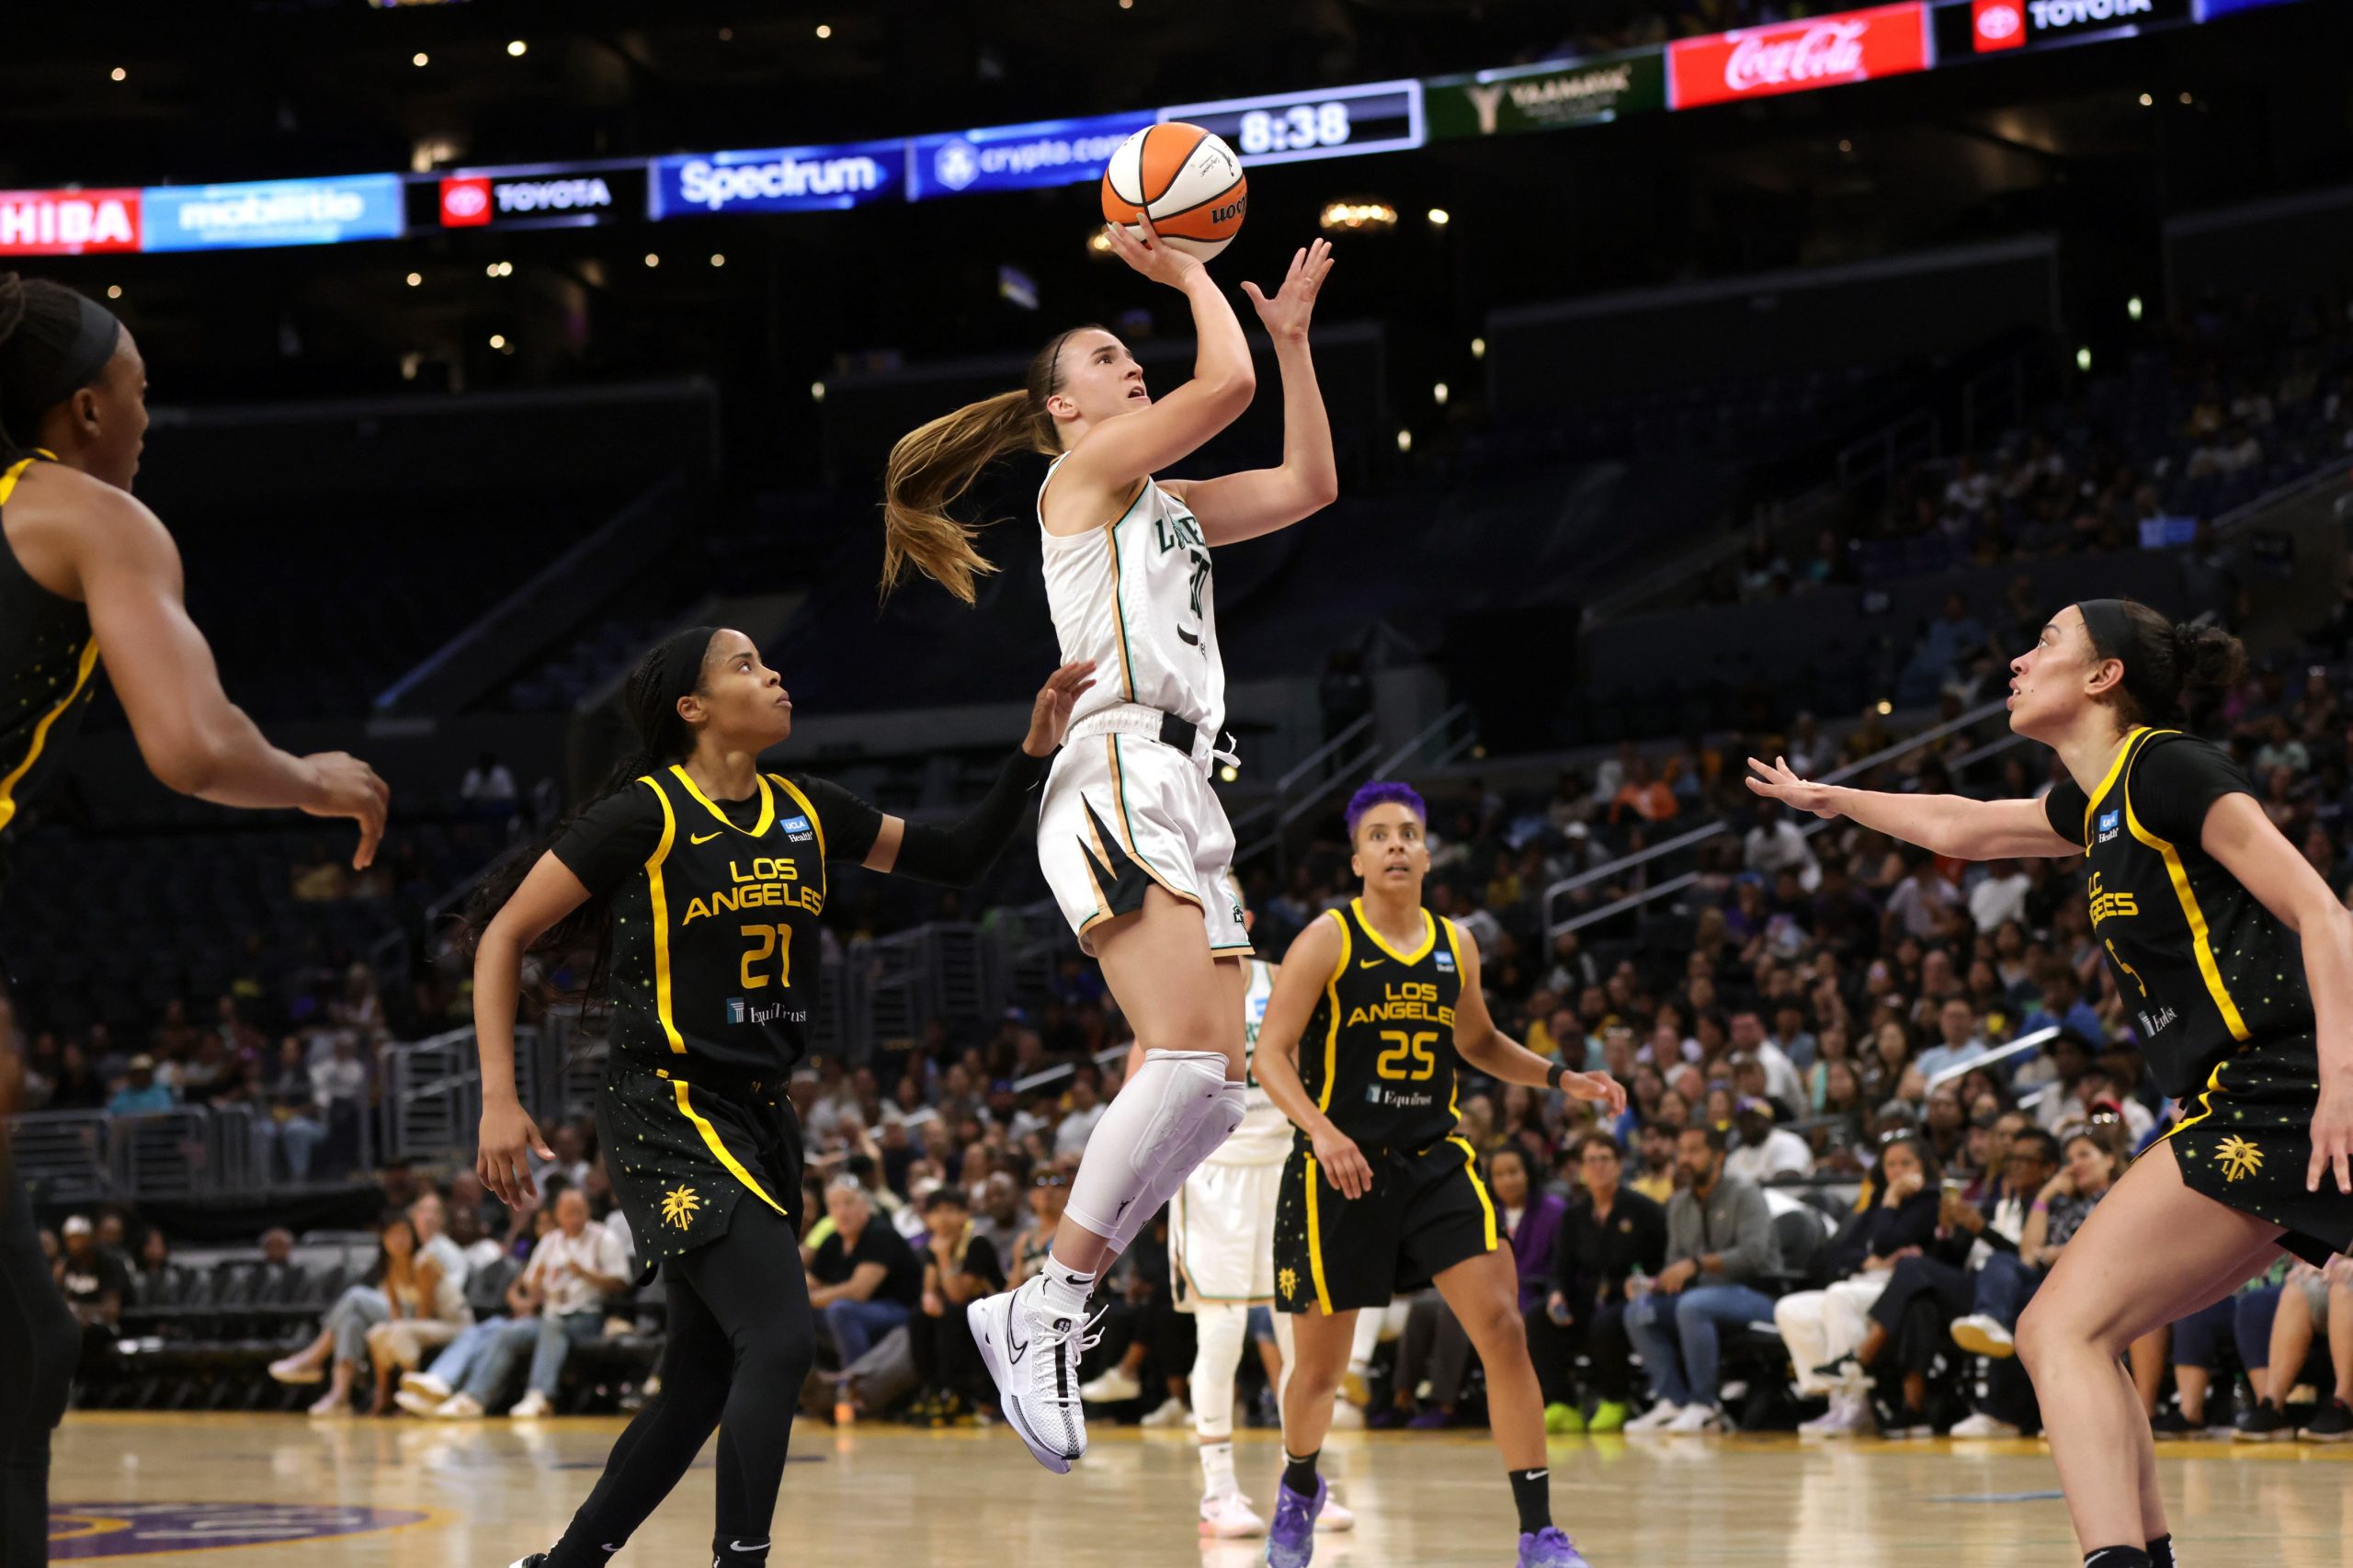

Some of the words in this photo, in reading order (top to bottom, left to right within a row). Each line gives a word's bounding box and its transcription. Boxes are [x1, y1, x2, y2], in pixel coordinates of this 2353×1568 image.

[1240, 101, 1350, 153] 8:38
[494, 178, 611, 212] TOYOTA
[680, 155, 876, 211] Spectrum
[785, 820, 805, 830] UCLA
[789, 832, 813, 843] Health
[730, 858, 798, 882] LOS
[682, 882, 824, 926] ANGELES
[741, 923, 792, 989] 21
[1385, 982, 1438, 1001] LOS
[749, 1003, 806, 1026] EquiTrust
[1347, 1001, 1455, 1028] ANGELE
[1377, 1030, 1438, 1080] 25
